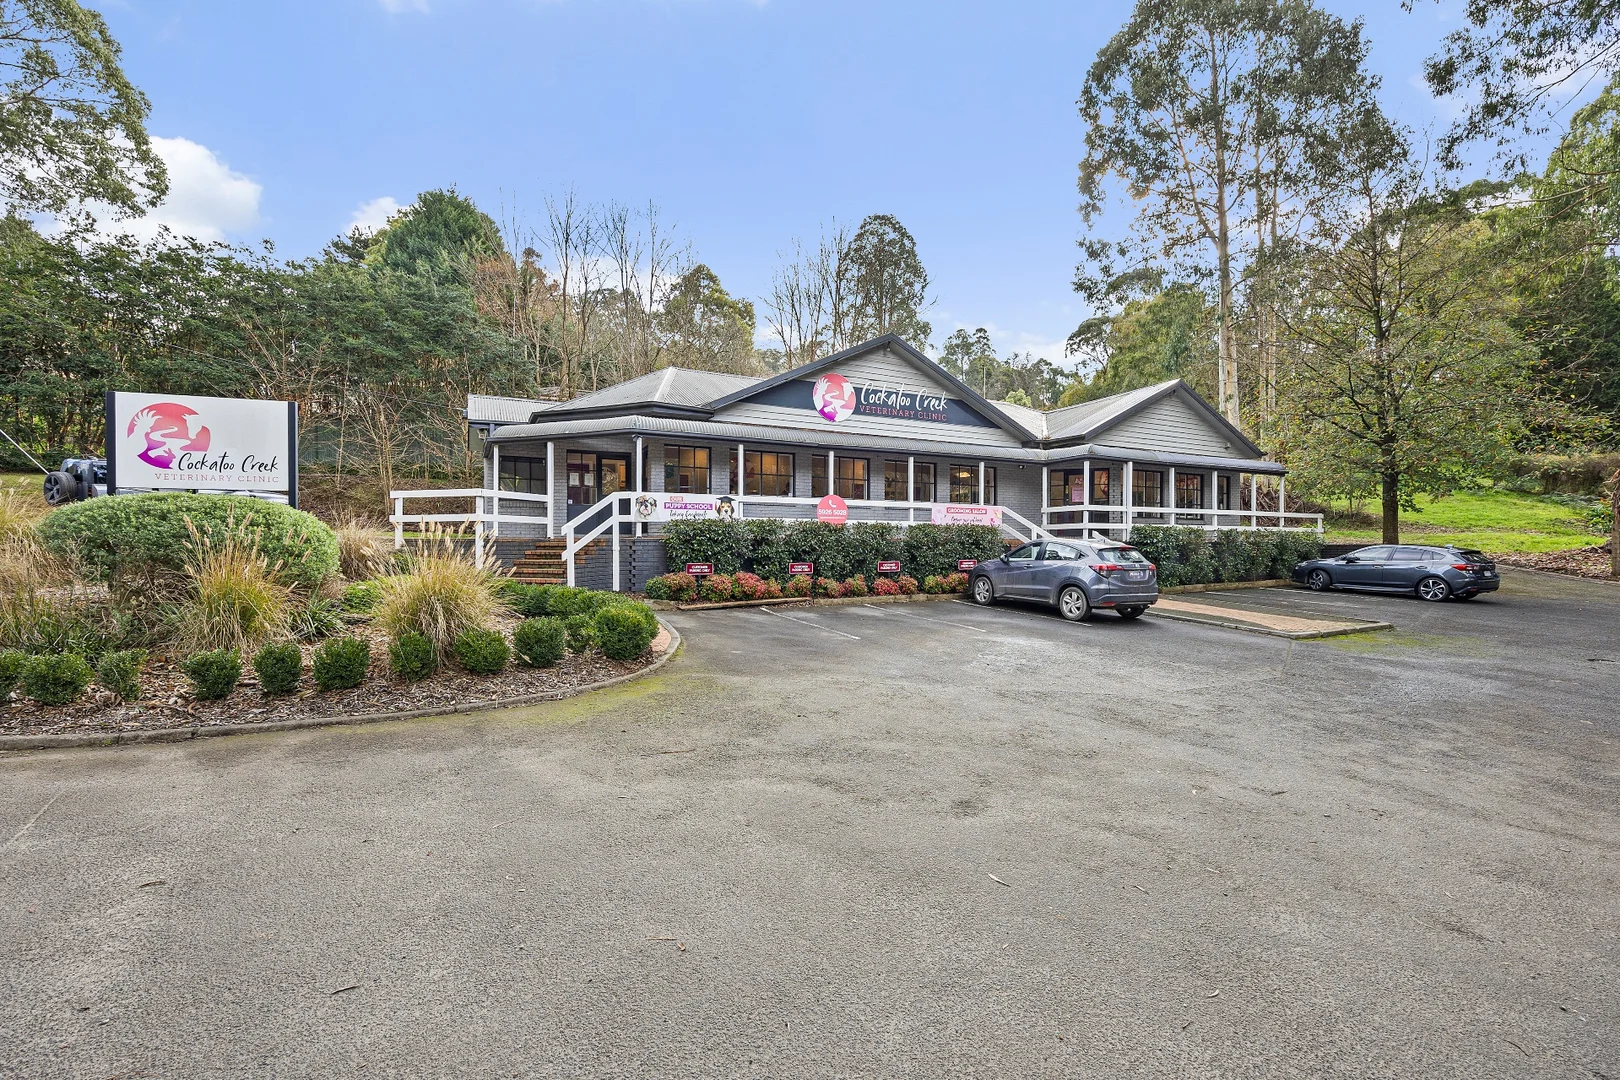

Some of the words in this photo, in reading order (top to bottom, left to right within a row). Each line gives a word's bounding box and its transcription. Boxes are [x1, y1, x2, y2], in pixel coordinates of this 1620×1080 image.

[861, 381, 910, 410] Cockatoo
[915, 388, 948, 411] Creek
[859, 405, 915, 418] VETERINARY
[917, 411, 948, 421] CLINIC
[178, 451, 235, 473] Cockatoo
[241, 454, 279, 473] Creek
[154, 473, 233, 483] VETERINARY
[237, 475, 279, 483] CLINIC
